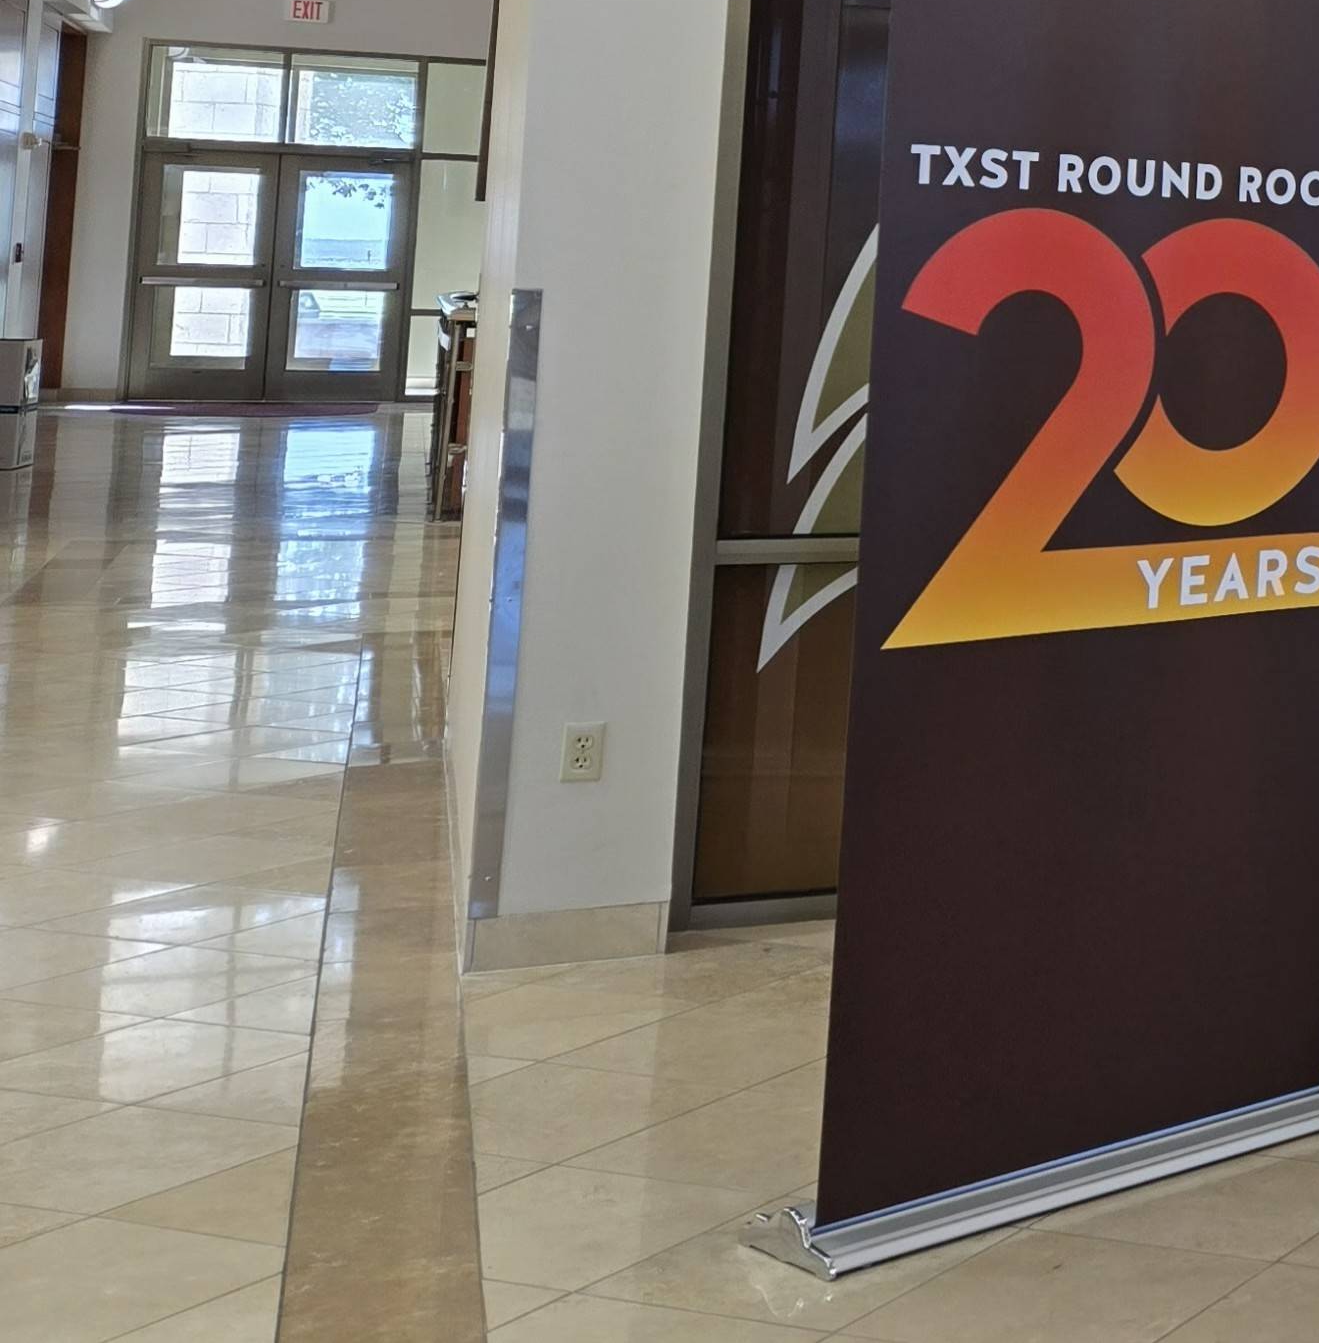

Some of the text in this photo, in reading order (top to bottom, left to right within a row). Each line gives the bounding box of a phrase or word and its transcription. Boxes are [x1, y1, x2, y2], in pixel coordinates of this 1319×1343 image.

[292, 0, 324, 21] EXIT
[910, 143, 1041, 191] TXST
[1056, 153, 1224, 200] ROUND
